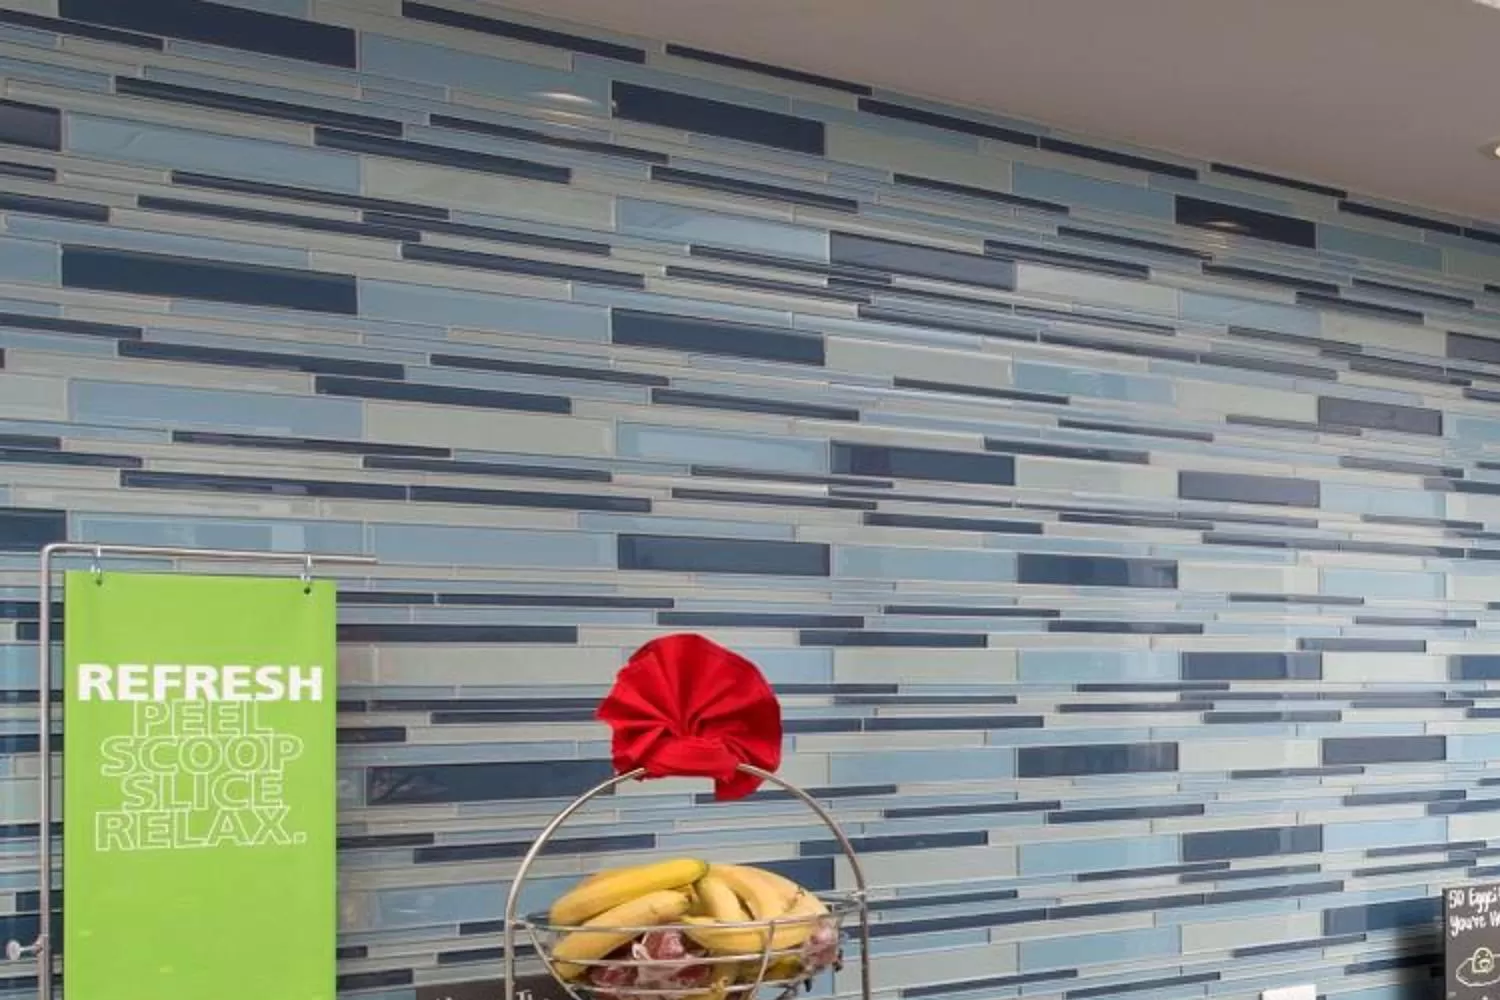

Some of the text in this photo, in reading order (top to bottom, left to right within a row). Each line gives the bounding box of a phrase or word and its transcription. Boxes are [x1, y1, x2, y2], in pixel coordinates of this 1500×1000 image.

[77, 663, 323, 702] REFRESH
[133, 699, 274, 738] PEEL
[100, 735, 304, 777] SCOOP
[120, 770, 284, 813] SLICE
[95, 806, 306, 852] RELAX.
